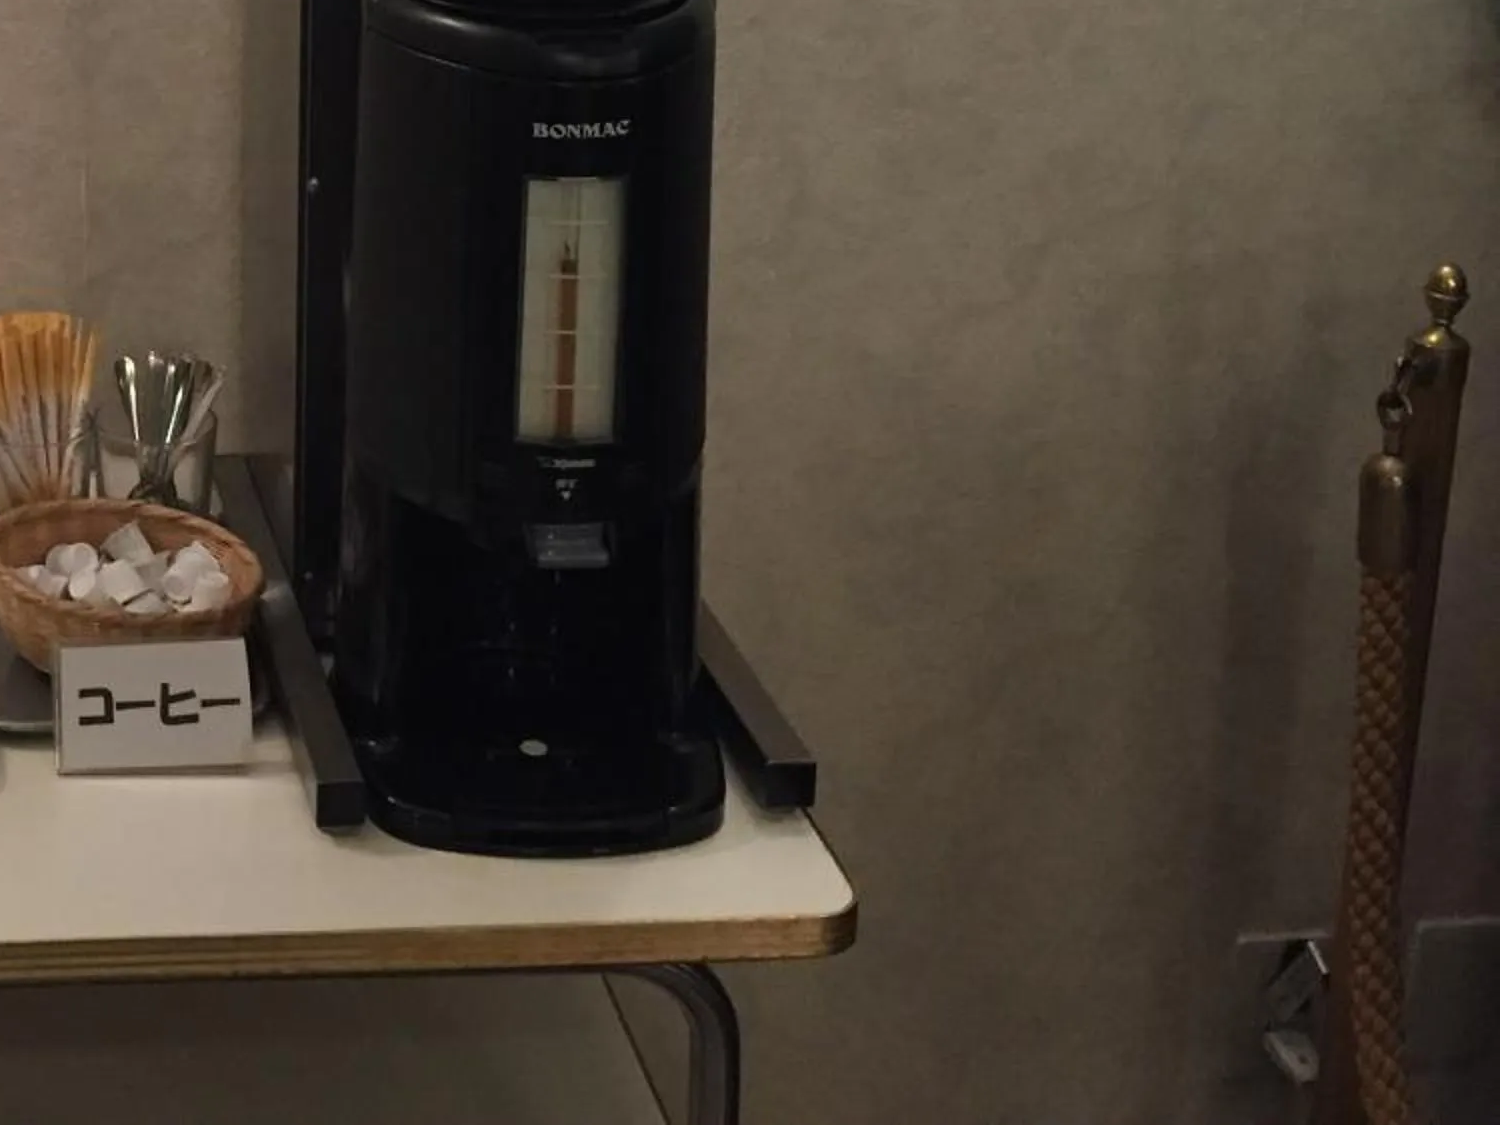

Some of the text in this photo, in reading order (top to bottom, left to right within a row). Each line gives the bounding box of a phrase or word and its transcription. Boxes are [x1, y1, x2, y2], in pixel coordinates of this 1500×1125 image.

[532, 118, 632, 139] BONMAC
[78, 682, 241, 726] コーヒー
